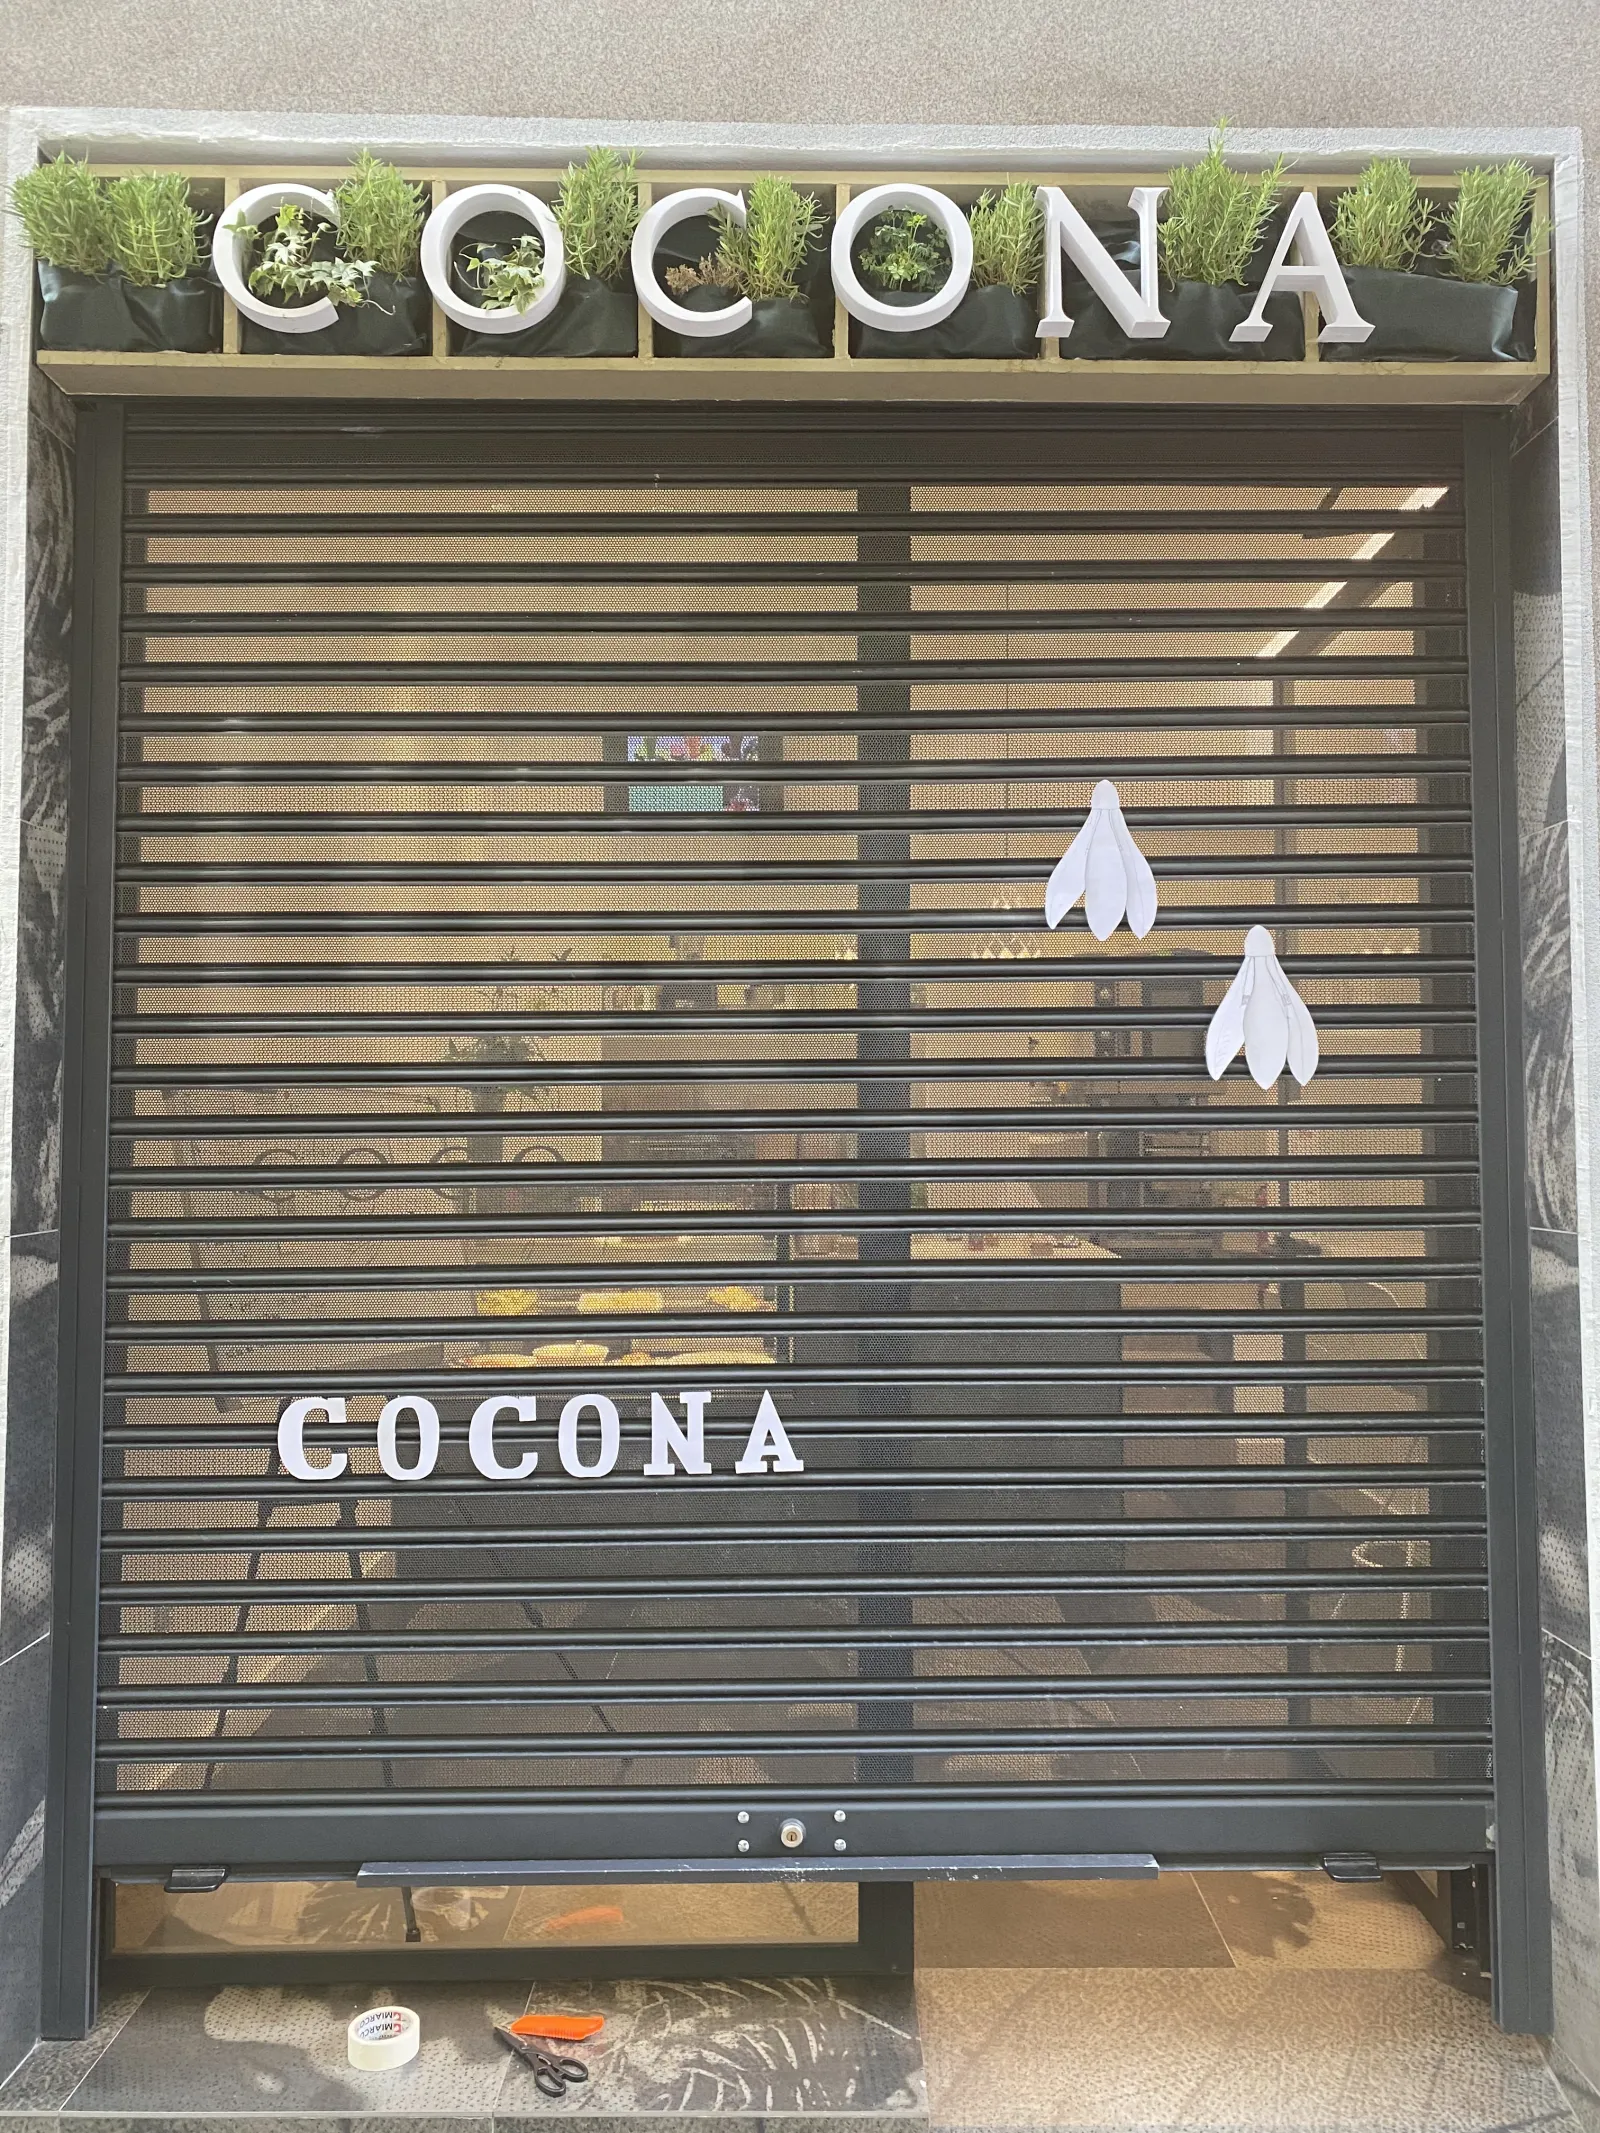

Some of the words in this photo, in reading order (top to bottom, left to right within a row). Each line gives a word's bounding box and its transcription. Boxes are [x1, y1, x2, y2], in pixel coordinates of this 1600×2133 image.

[212, 181, 1376, 343] COCONA
[276, 1388, 805, 1481] COCONA
[359, 2011, 393, 2029] MIARCO
